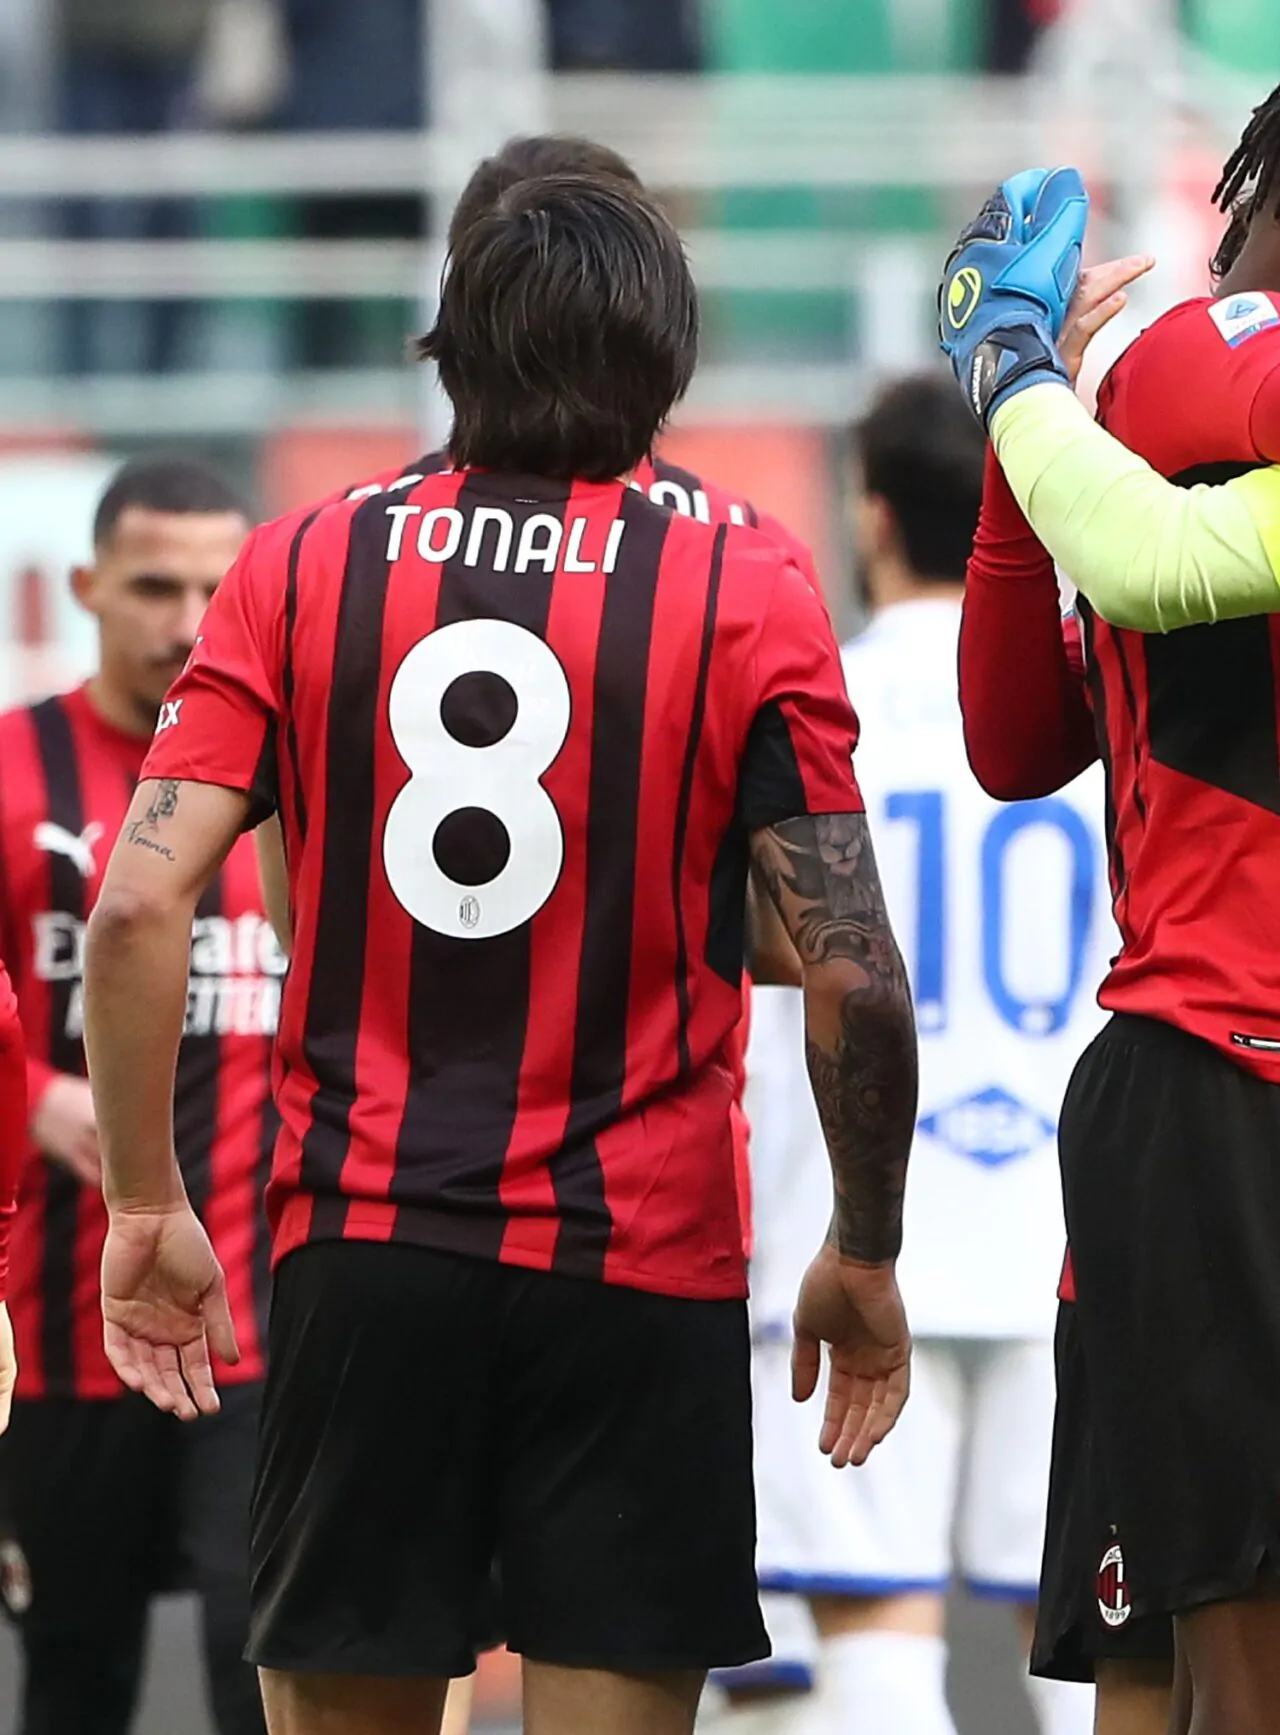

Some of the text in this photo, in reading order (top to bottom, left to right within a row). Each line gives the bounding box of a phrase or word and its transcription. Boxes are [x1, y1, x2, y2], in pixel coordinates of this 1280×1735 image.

[384, 505, 626, 574] TONALI
[383, 618, 571, 938] 8
[882, 786, 1098, 1037] 10
